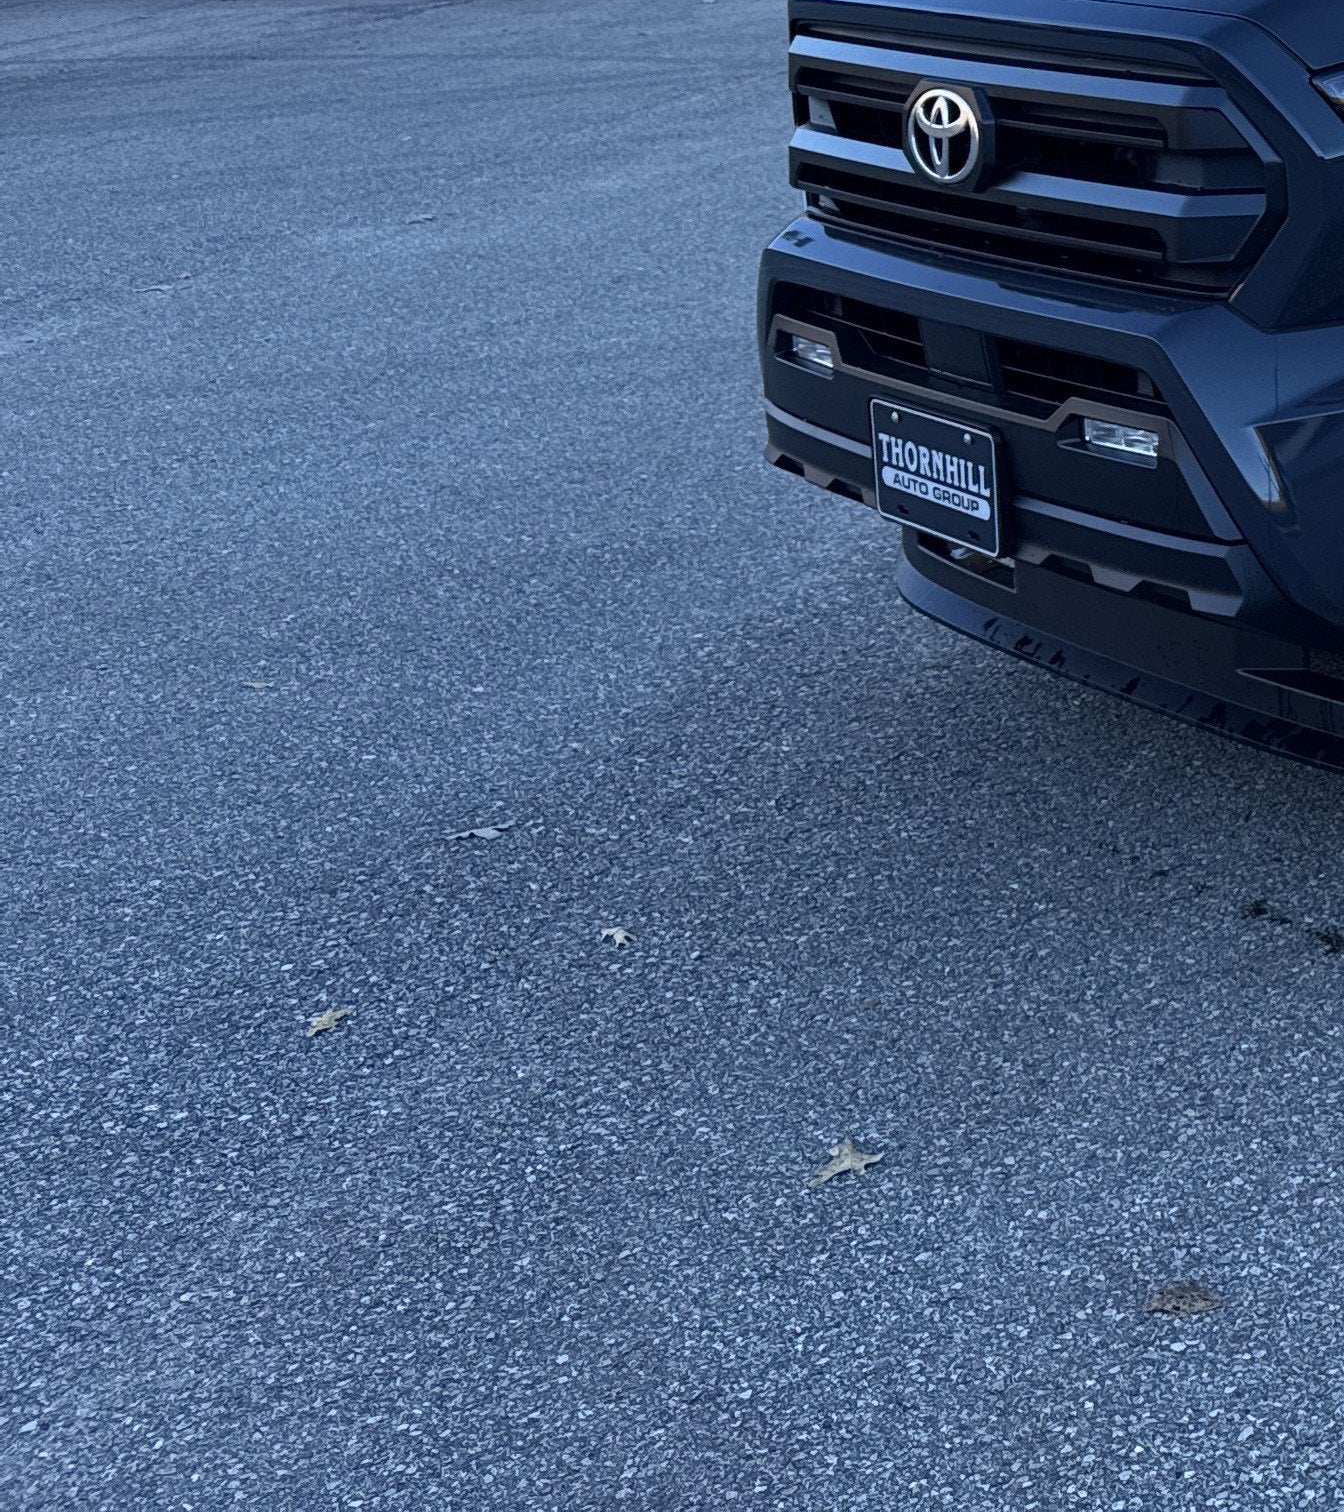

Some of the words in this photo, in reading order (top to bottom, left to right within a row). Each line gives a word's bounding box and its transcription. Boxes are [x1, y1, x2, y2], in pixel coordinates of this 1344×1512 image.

[878, 432, 991, 497] THORNHILL
[893, 473, 929, 496] AUTO
[932, 486, 980, 512] GROUP
